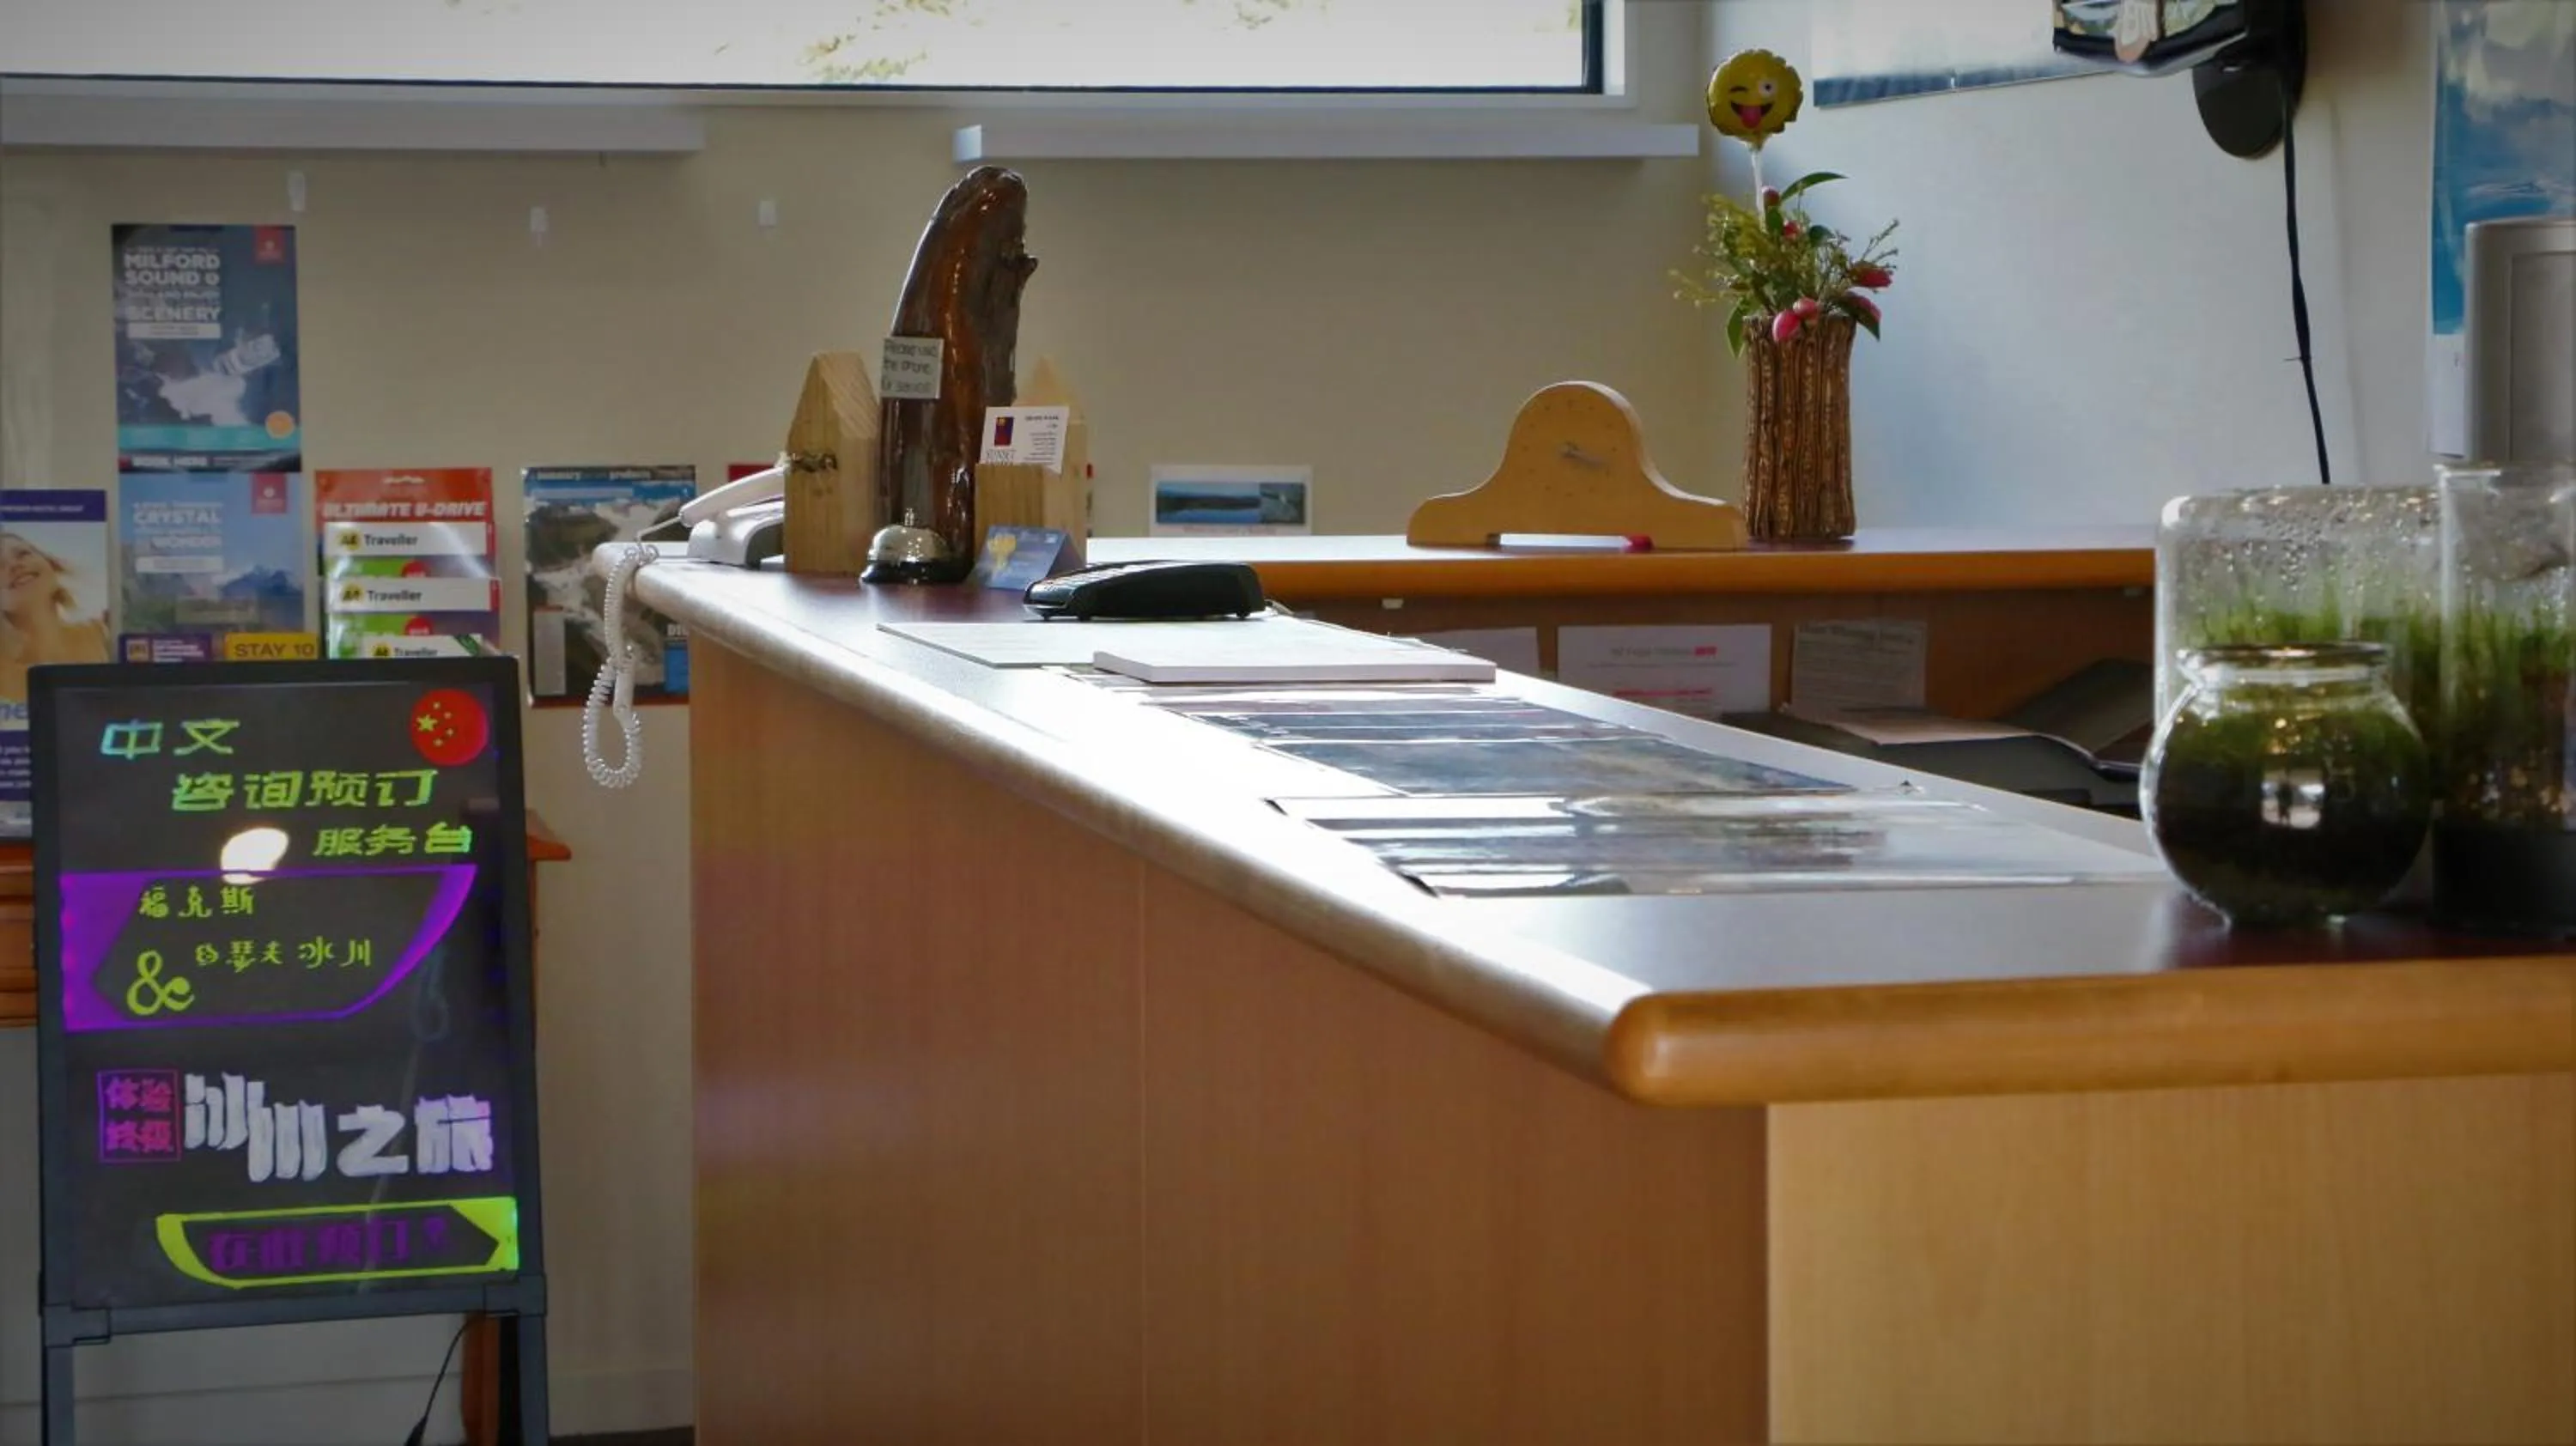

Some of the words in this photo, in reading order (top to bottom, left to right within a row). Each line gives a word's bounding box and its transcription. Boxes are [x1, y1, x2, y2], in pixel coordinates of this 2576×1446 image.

[124, 253, 221, 270] MILFORD
[125, 270, 200, 286] SOUND
[126, 307, 222, 321] SCENERY
[134, 510, 223, 525] CRYSTAL
[324, 501, 412, 518] ULTIMATE
[415, 501, 488, 517] U-DRIVE
[363, 533, 419, 546] Traveller
[368, 589, 423, 602] Traveller
[234, 643, 289, 658] STAY
[294, 642, 316, 657] 10
[393, 646, 439, 657] Traveller
[100, 719, 240, 760] 中文
[172, 769, 439, 812] 咨询预订
[313, 822, 473, 857] 服务台
[138, 884, 254, 919] 福克斯
[126, 949, 196, 1017] &
[104, 1077, 173, 1114] 体验
[184, 1071, 494, 1182] 冰川之旅
